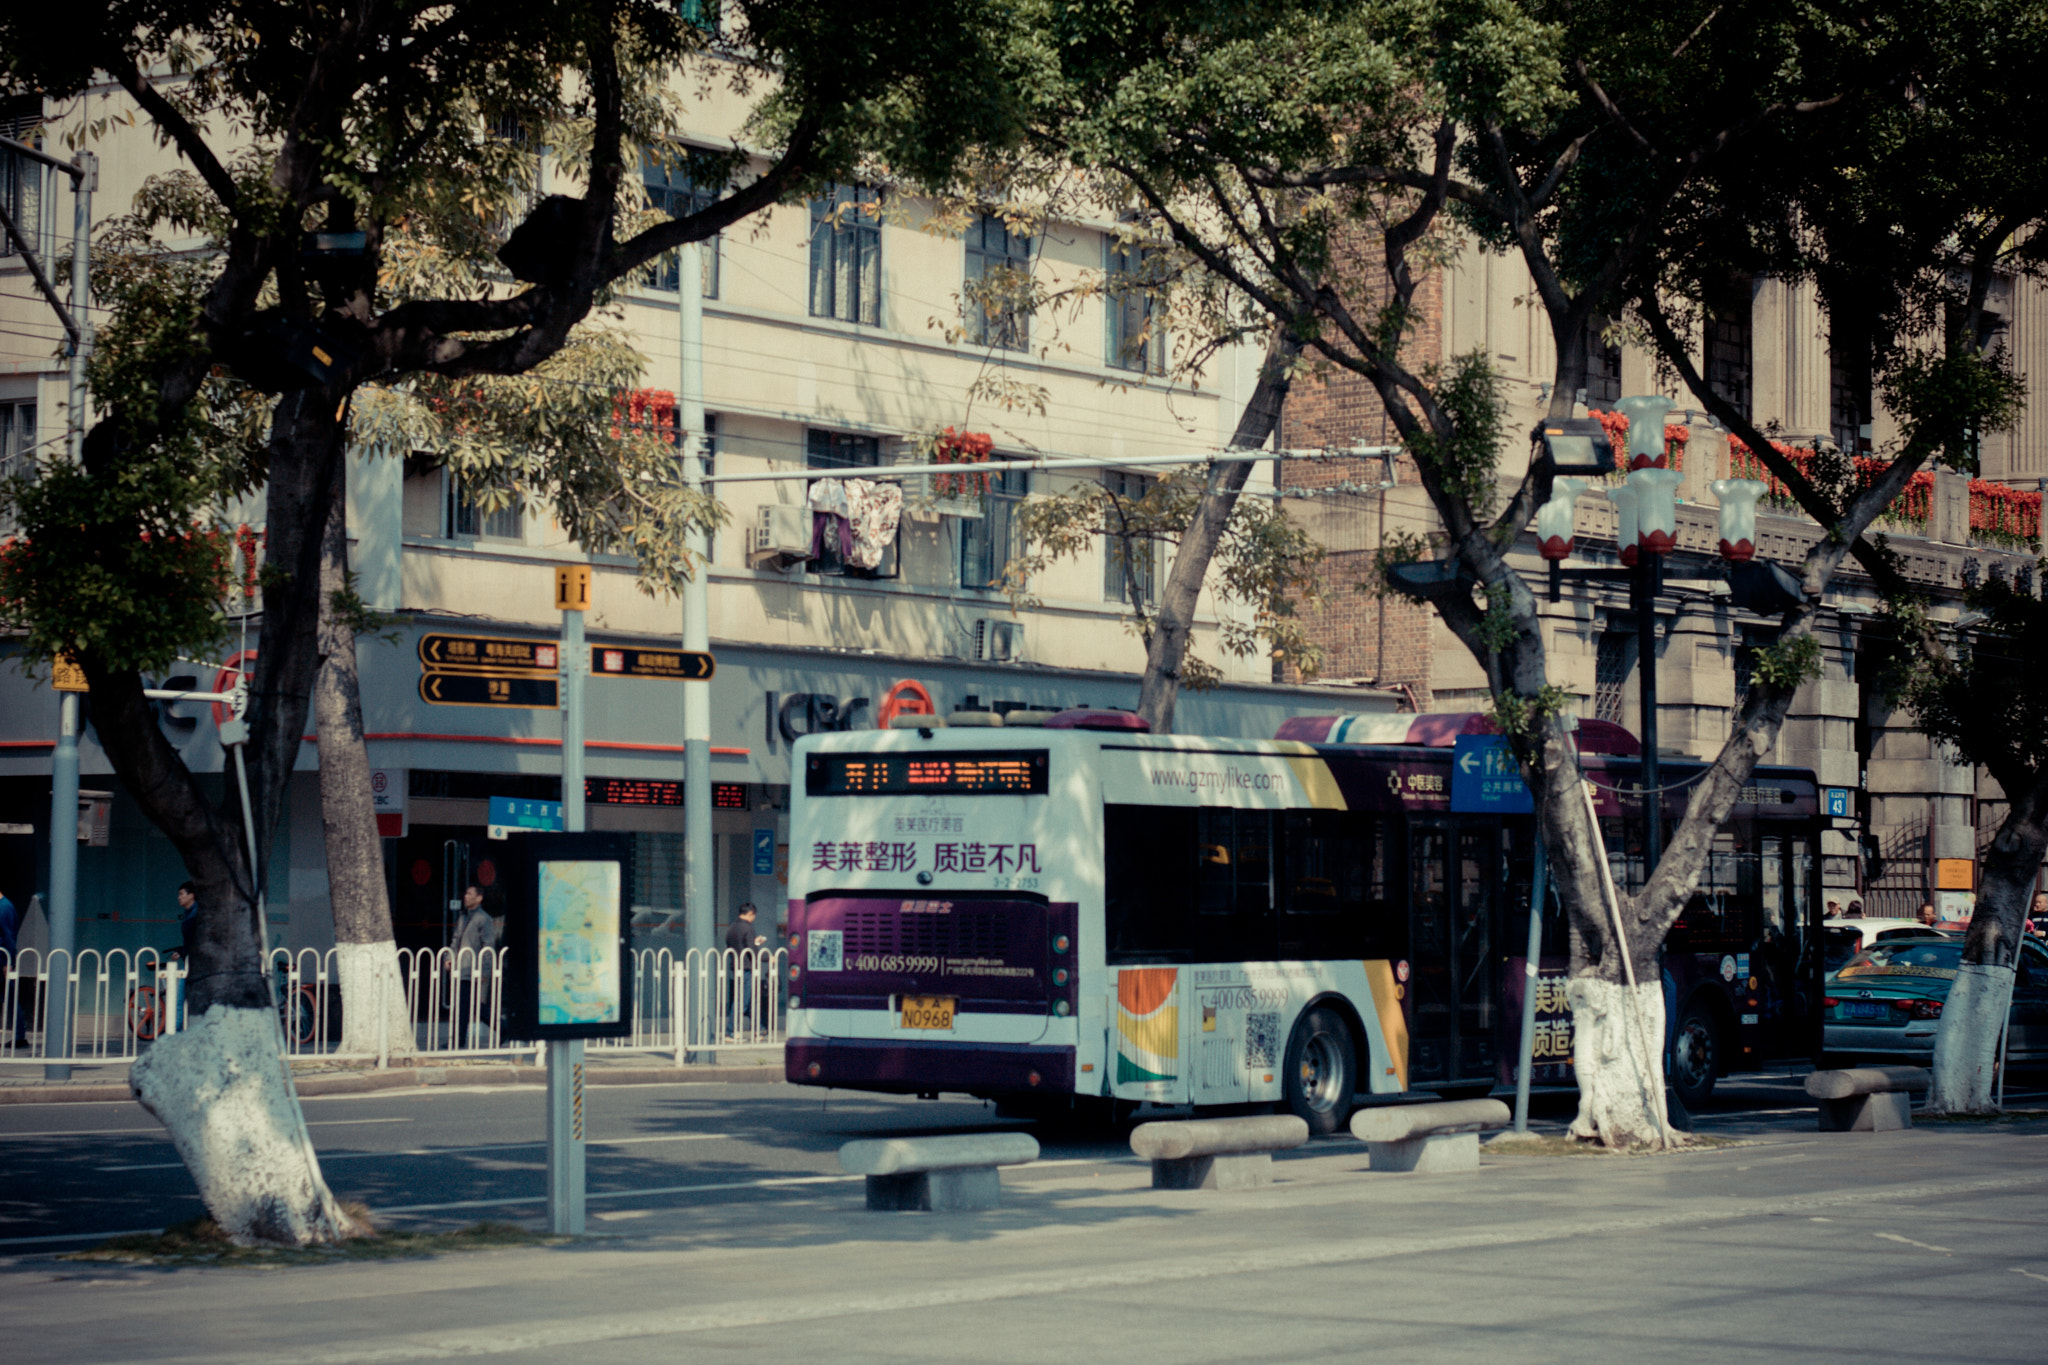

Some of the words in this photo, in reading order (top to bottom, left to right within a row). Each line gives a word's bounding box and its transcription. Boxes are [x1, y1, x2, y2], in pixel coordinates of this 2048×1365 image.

[1151, 766, 1284, 794] www.gzmylike.com
[1408, 774, 1443, 791] 中医美容
[1833, 800, 1842, 814] 43
[812, 842, 917, 872] 美莱整形
[933, 843, 1042, 874] 质造不凡
[855, 955, 880, 972] 400
[881, 956, 904, 973] 685
[905, 957, 939, 974] 9999
[1211, 989, 1233, 1009] 400
[1235, 989, 1257, 1010] 685
[1259, 988, 1289, 1010] 9999
[903, 1010, 949, 1028] N0968
[1531, 1019, 1575, 1058] 质造
